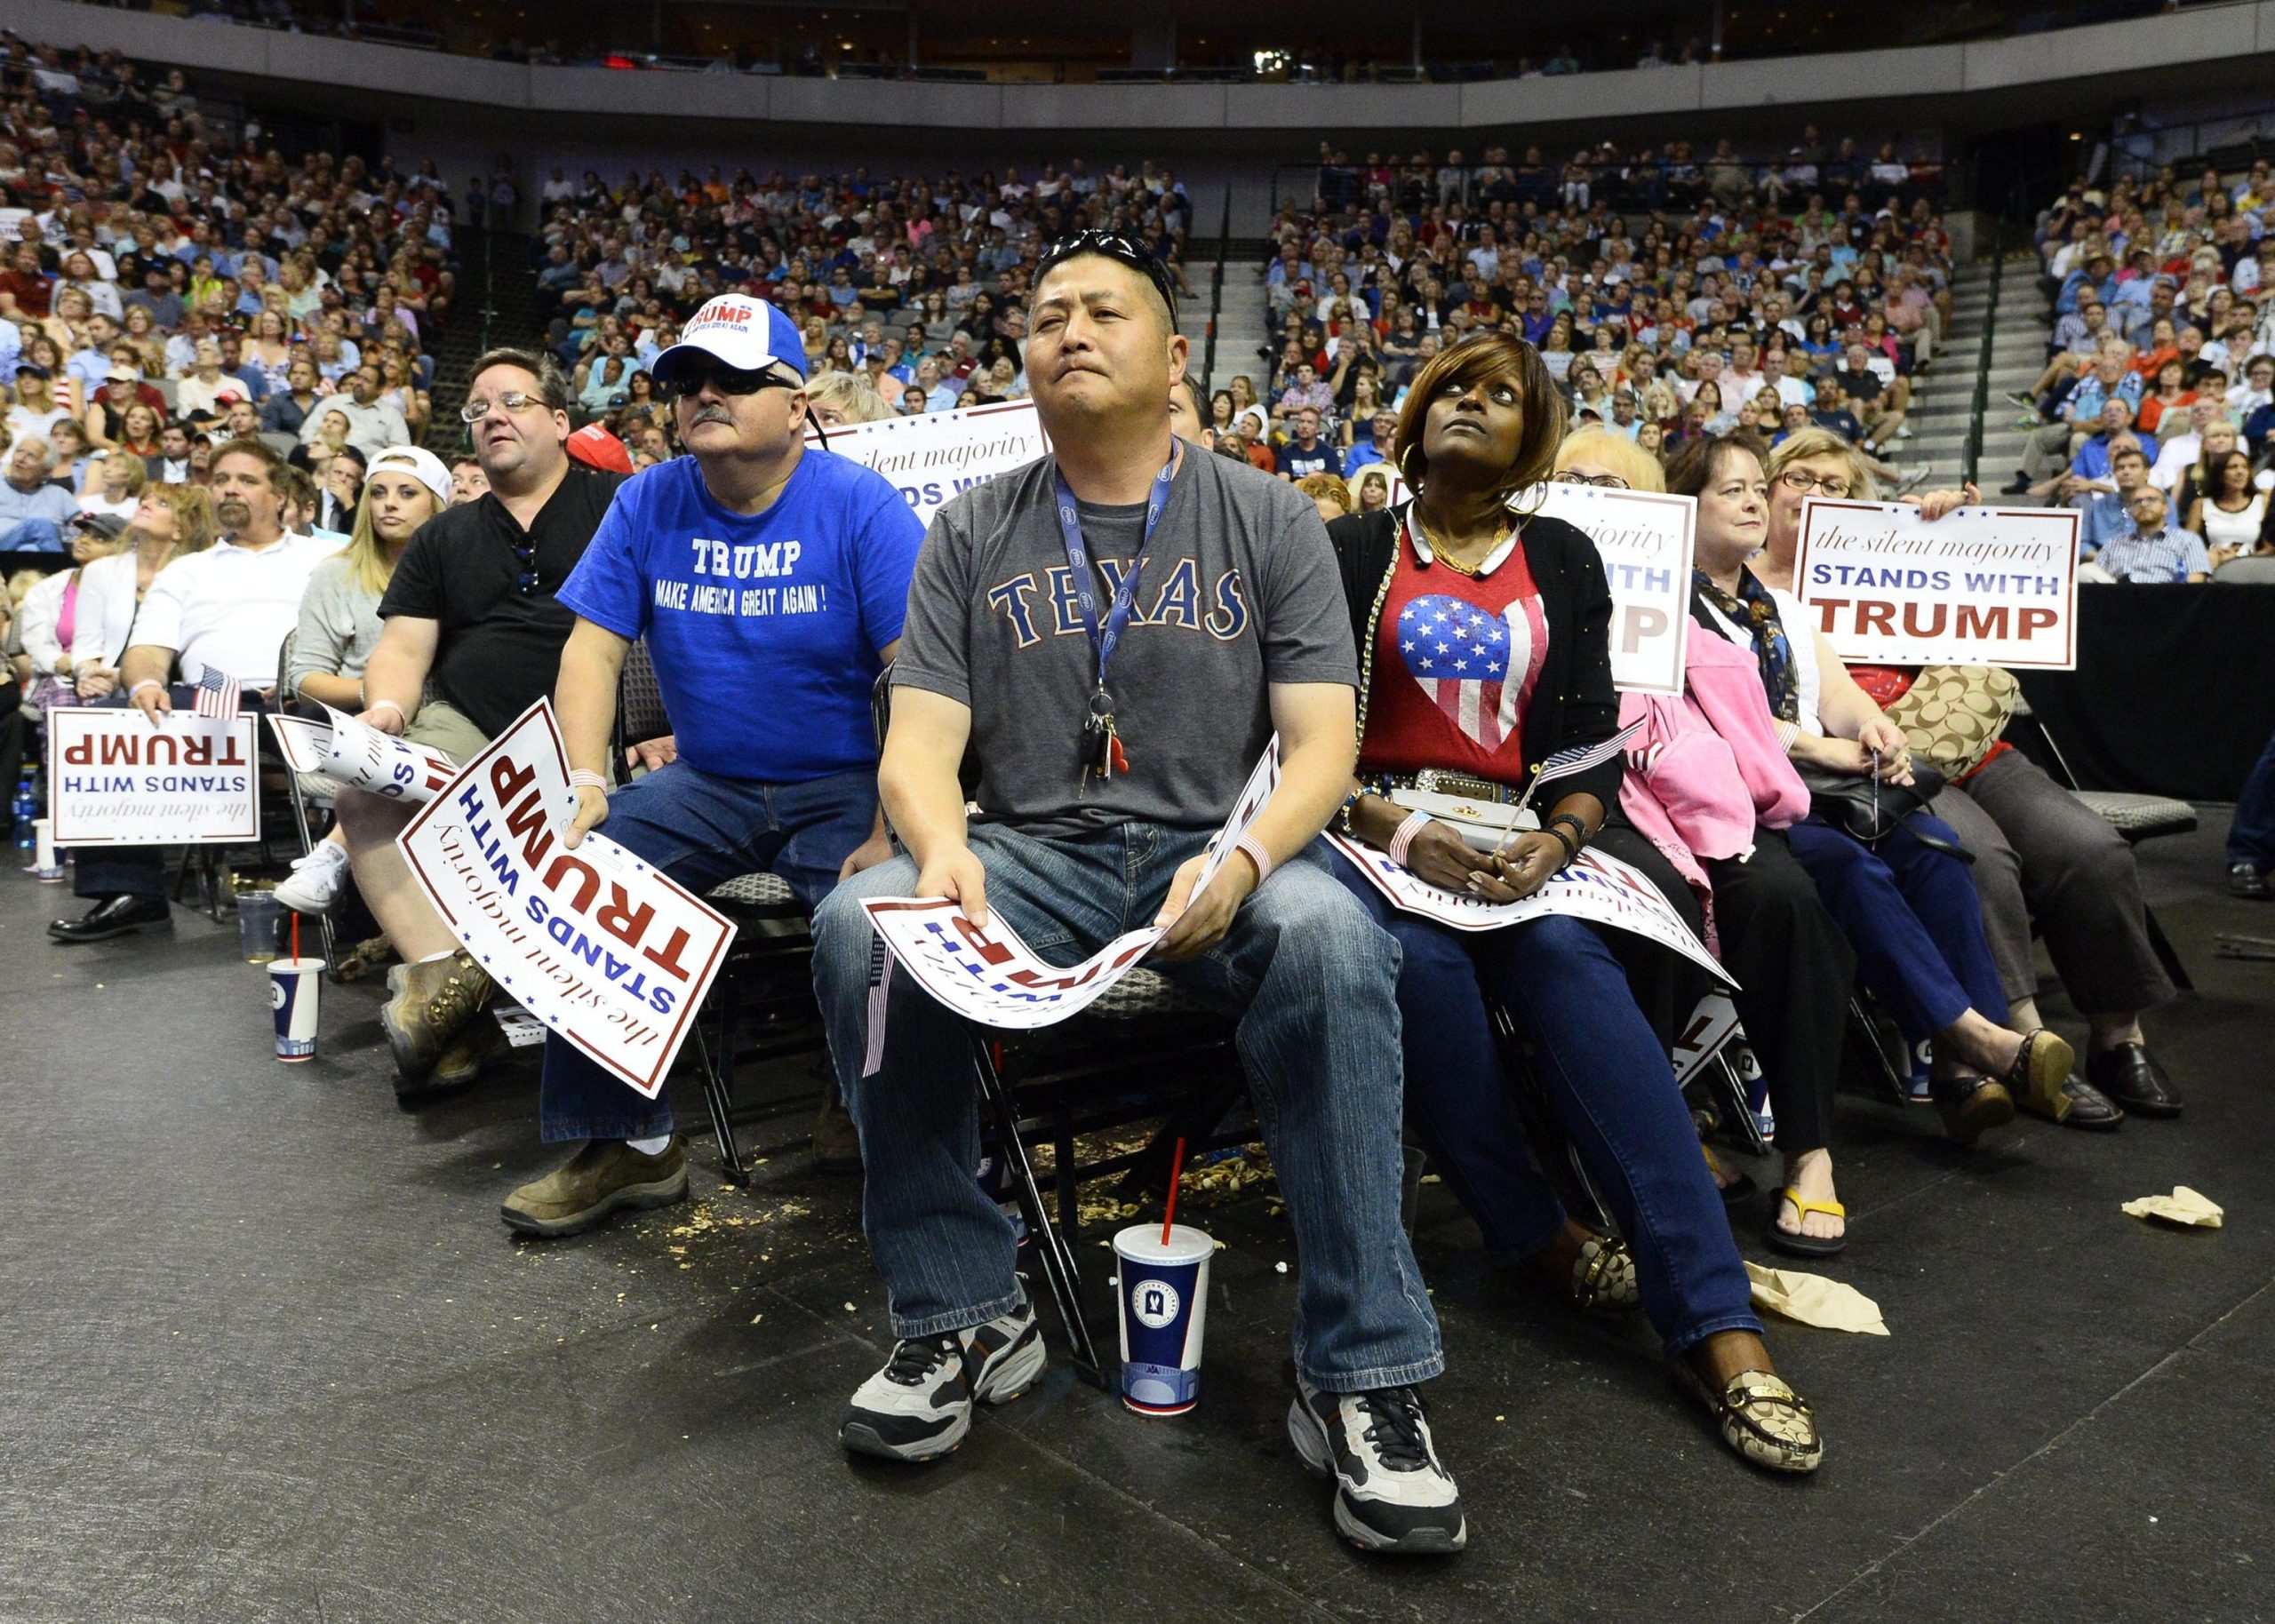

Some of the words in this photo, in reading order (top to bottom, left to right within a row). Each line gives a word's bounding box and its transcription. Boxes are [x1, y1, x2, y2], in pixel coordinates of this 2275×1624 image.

[864, 450, 915, 474] ilent
[923, 431, 1034, 472] majority
[691, 537, 802, 579] TRUMP
[1815, 526, 1857, 553] the
[1862, 530, 1934, 556] silent
[1939, 536, 2063, 569] majority
[655, 579, 689, 610] MAKE
[690, 585, 735, 616] AMERICA
[741, 587, 777, 617] GREAT
[1606, 561, 1672, 594] ITH
[1812, 563, 1952, 591] STANDS
[1966, 572, 2059, 596] WITH
[986, 557, 1249, 649] TEXAS
[1809, 597, 2059, 641] TRUMP
[64, 733, 246, 767] TRUMP
[65, 776, 134, 792] WITH
[145, 776, 246, 792] STANDS
[64, 798, 156, 824] majority
[160, 802, 210, 823] silent
[217, 802, 248, 823] the
[458, 783, 521, 897] WITH
[433, 823, 529, 947] majority
[490, 754, 690, 983] TRUMP
[525, 895, 676, 1015] STANDS
[524, 944, 609, 1010] silent
[607, 1007, 659, 1047] the
